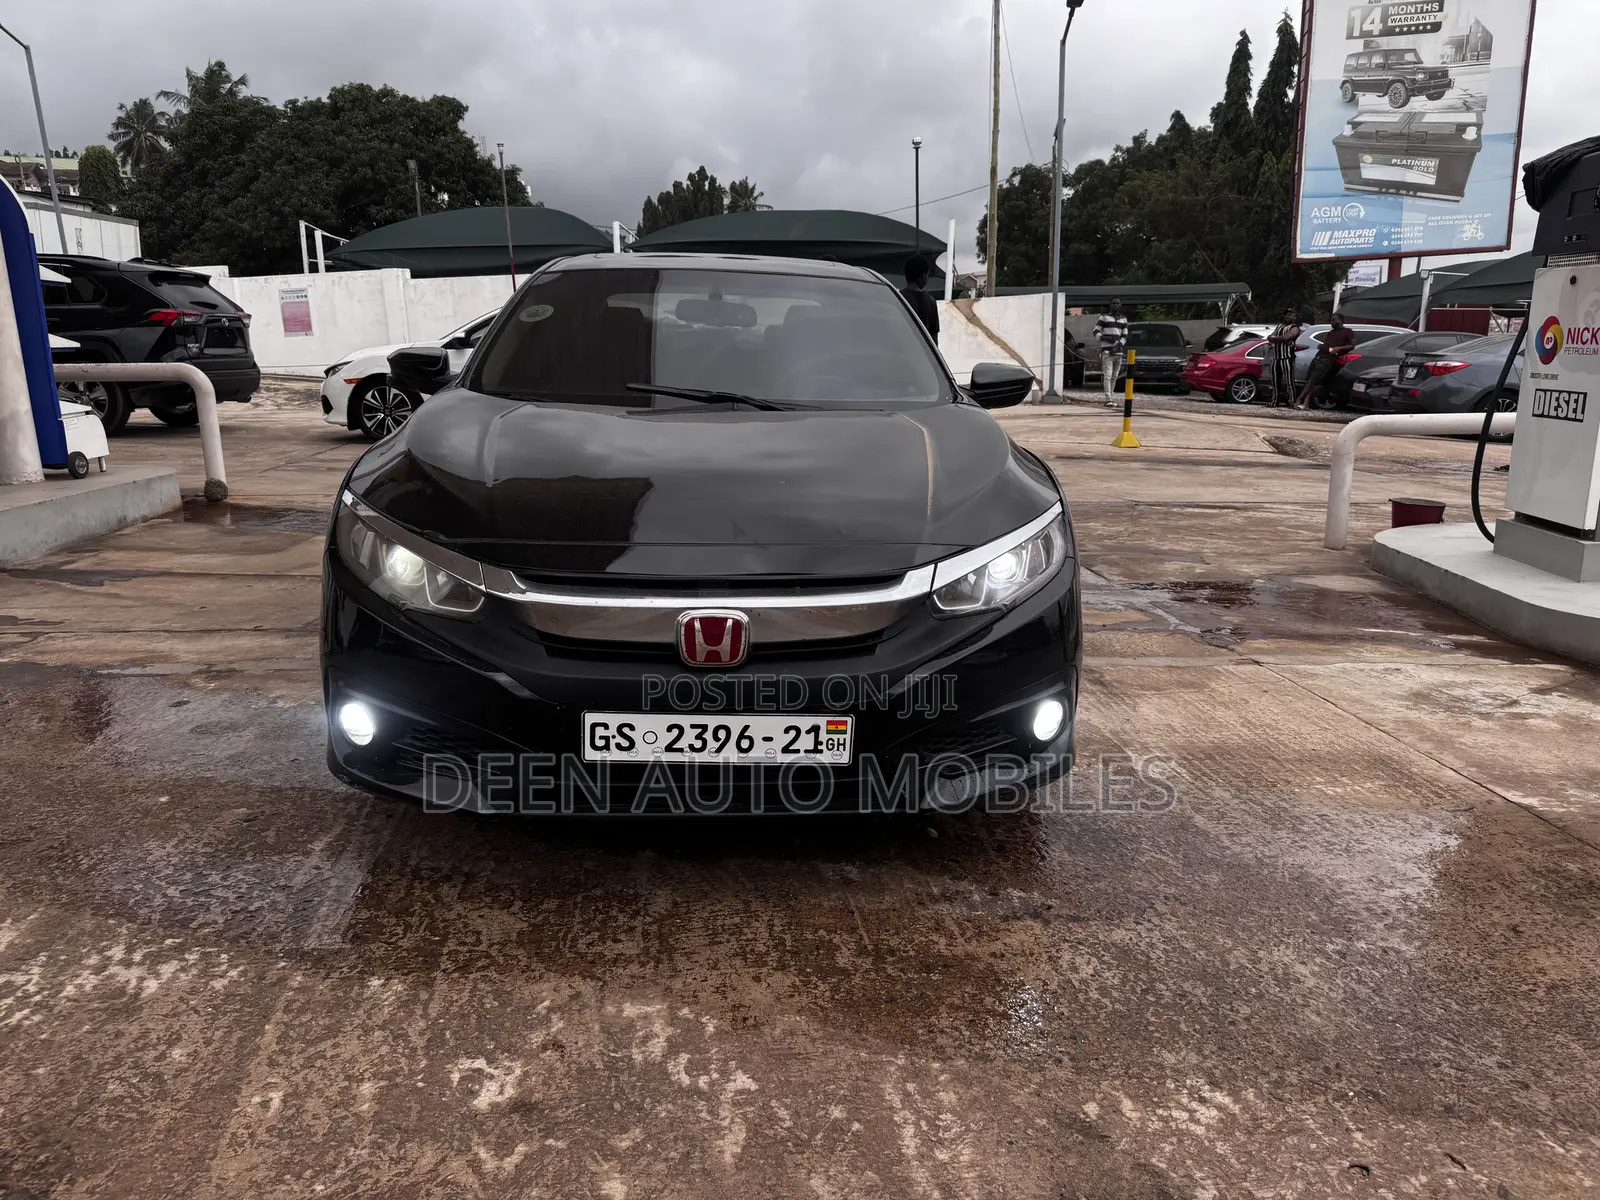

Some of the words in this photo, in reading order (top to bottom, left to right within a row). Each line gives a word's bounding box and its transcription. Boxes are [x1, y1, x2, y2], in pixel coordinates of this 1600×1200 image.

[1388, 2, 1440, 15] MONTHS
[1350, 6, 1383, 37] 14
[1390, 14, 1438, 24] WARRANTY
[1391, 158, 1435, 167] PLATINUM
[1310, 206, 1342, 218] AGM
[1332, 229, 1377, 239] MAXPRO
[1329, 236, 1375, 246] AUTOPARTS
[1565, 326, 1600, 346] NICK
[1563, 346, 1599, 356] PETROLEUM
[1533, 390, 1584, 420] DIESEL
[825, 737, 847, 752] GH
